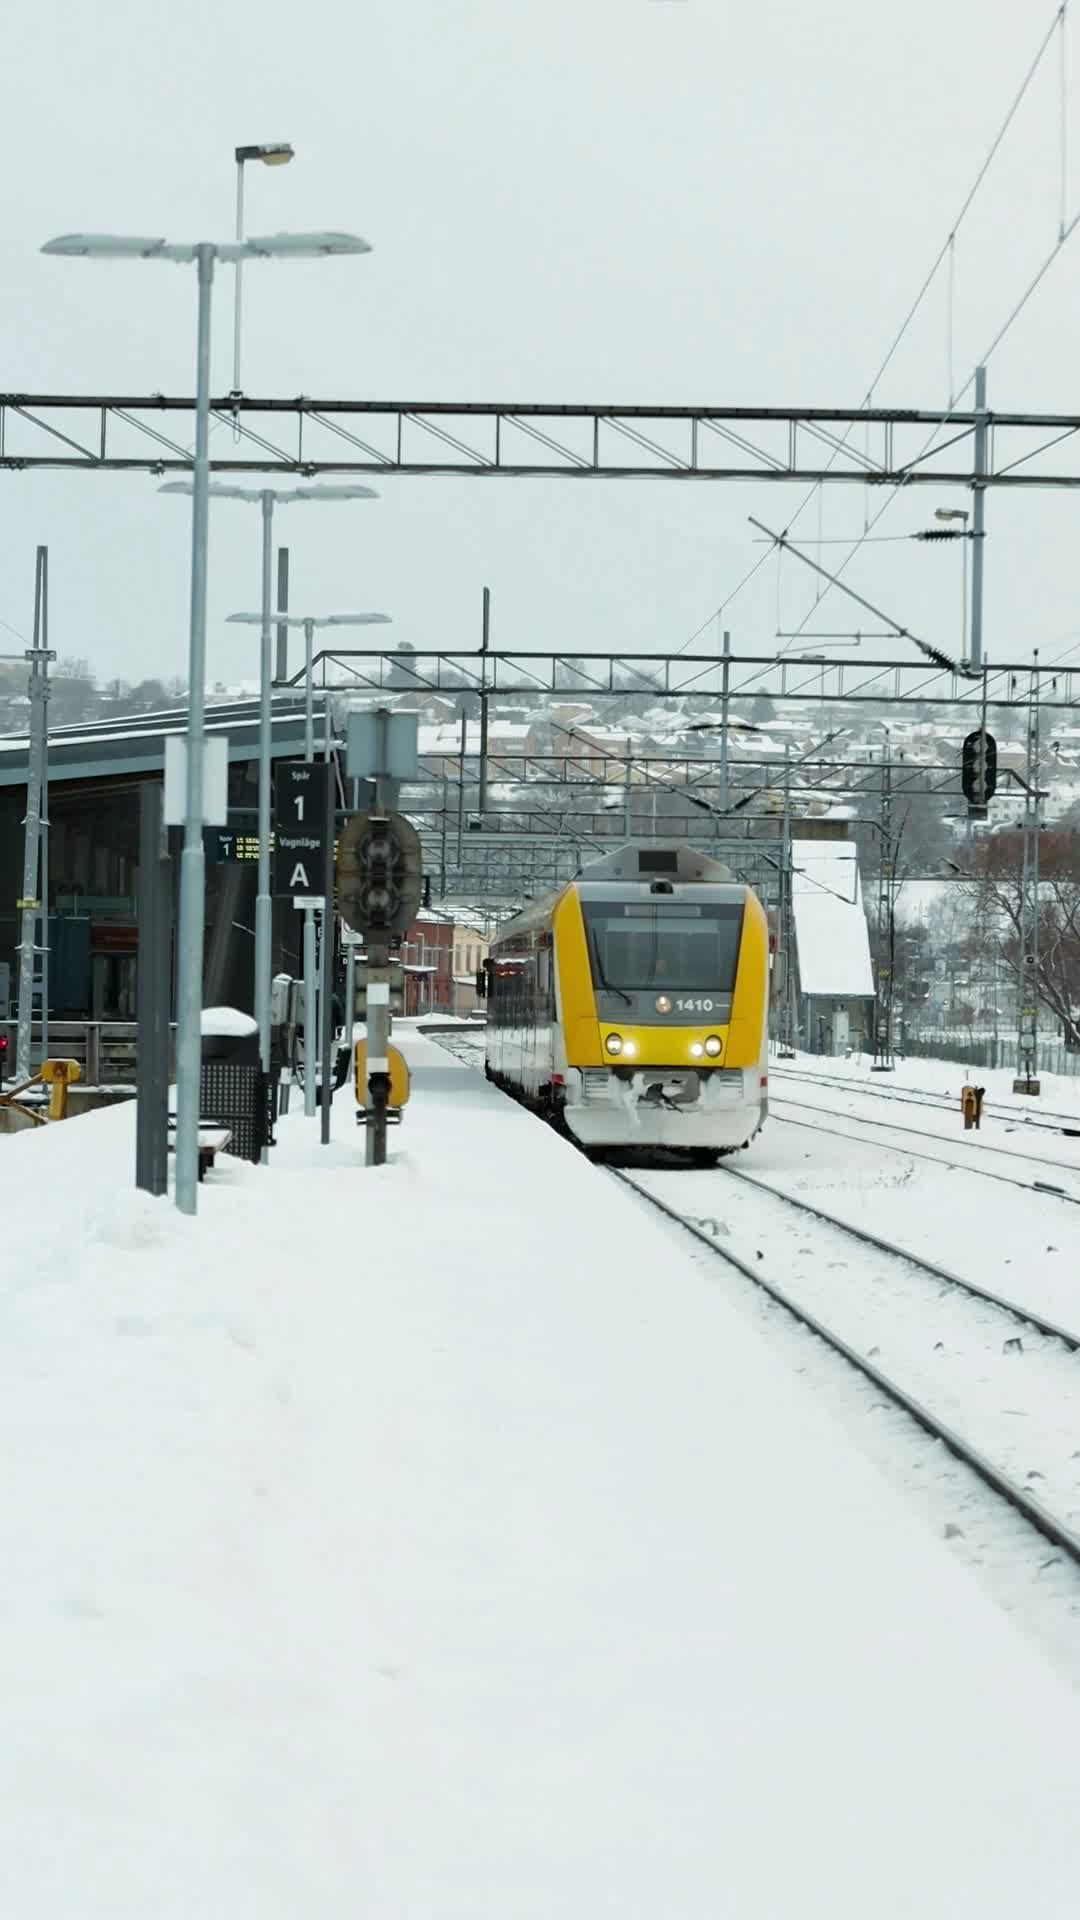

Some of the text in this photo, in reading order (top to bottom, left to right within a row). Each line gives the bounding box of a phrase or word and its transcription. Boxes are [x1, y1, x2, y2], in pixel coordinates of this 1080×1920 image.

[293, 795, 304, 821] 1
[223, 843, 229, 856] 1
[279, 837, 321, 849] Vagnläge
[289, 863, 310, 887] A
[675, 999, 713, 1012] 1410
